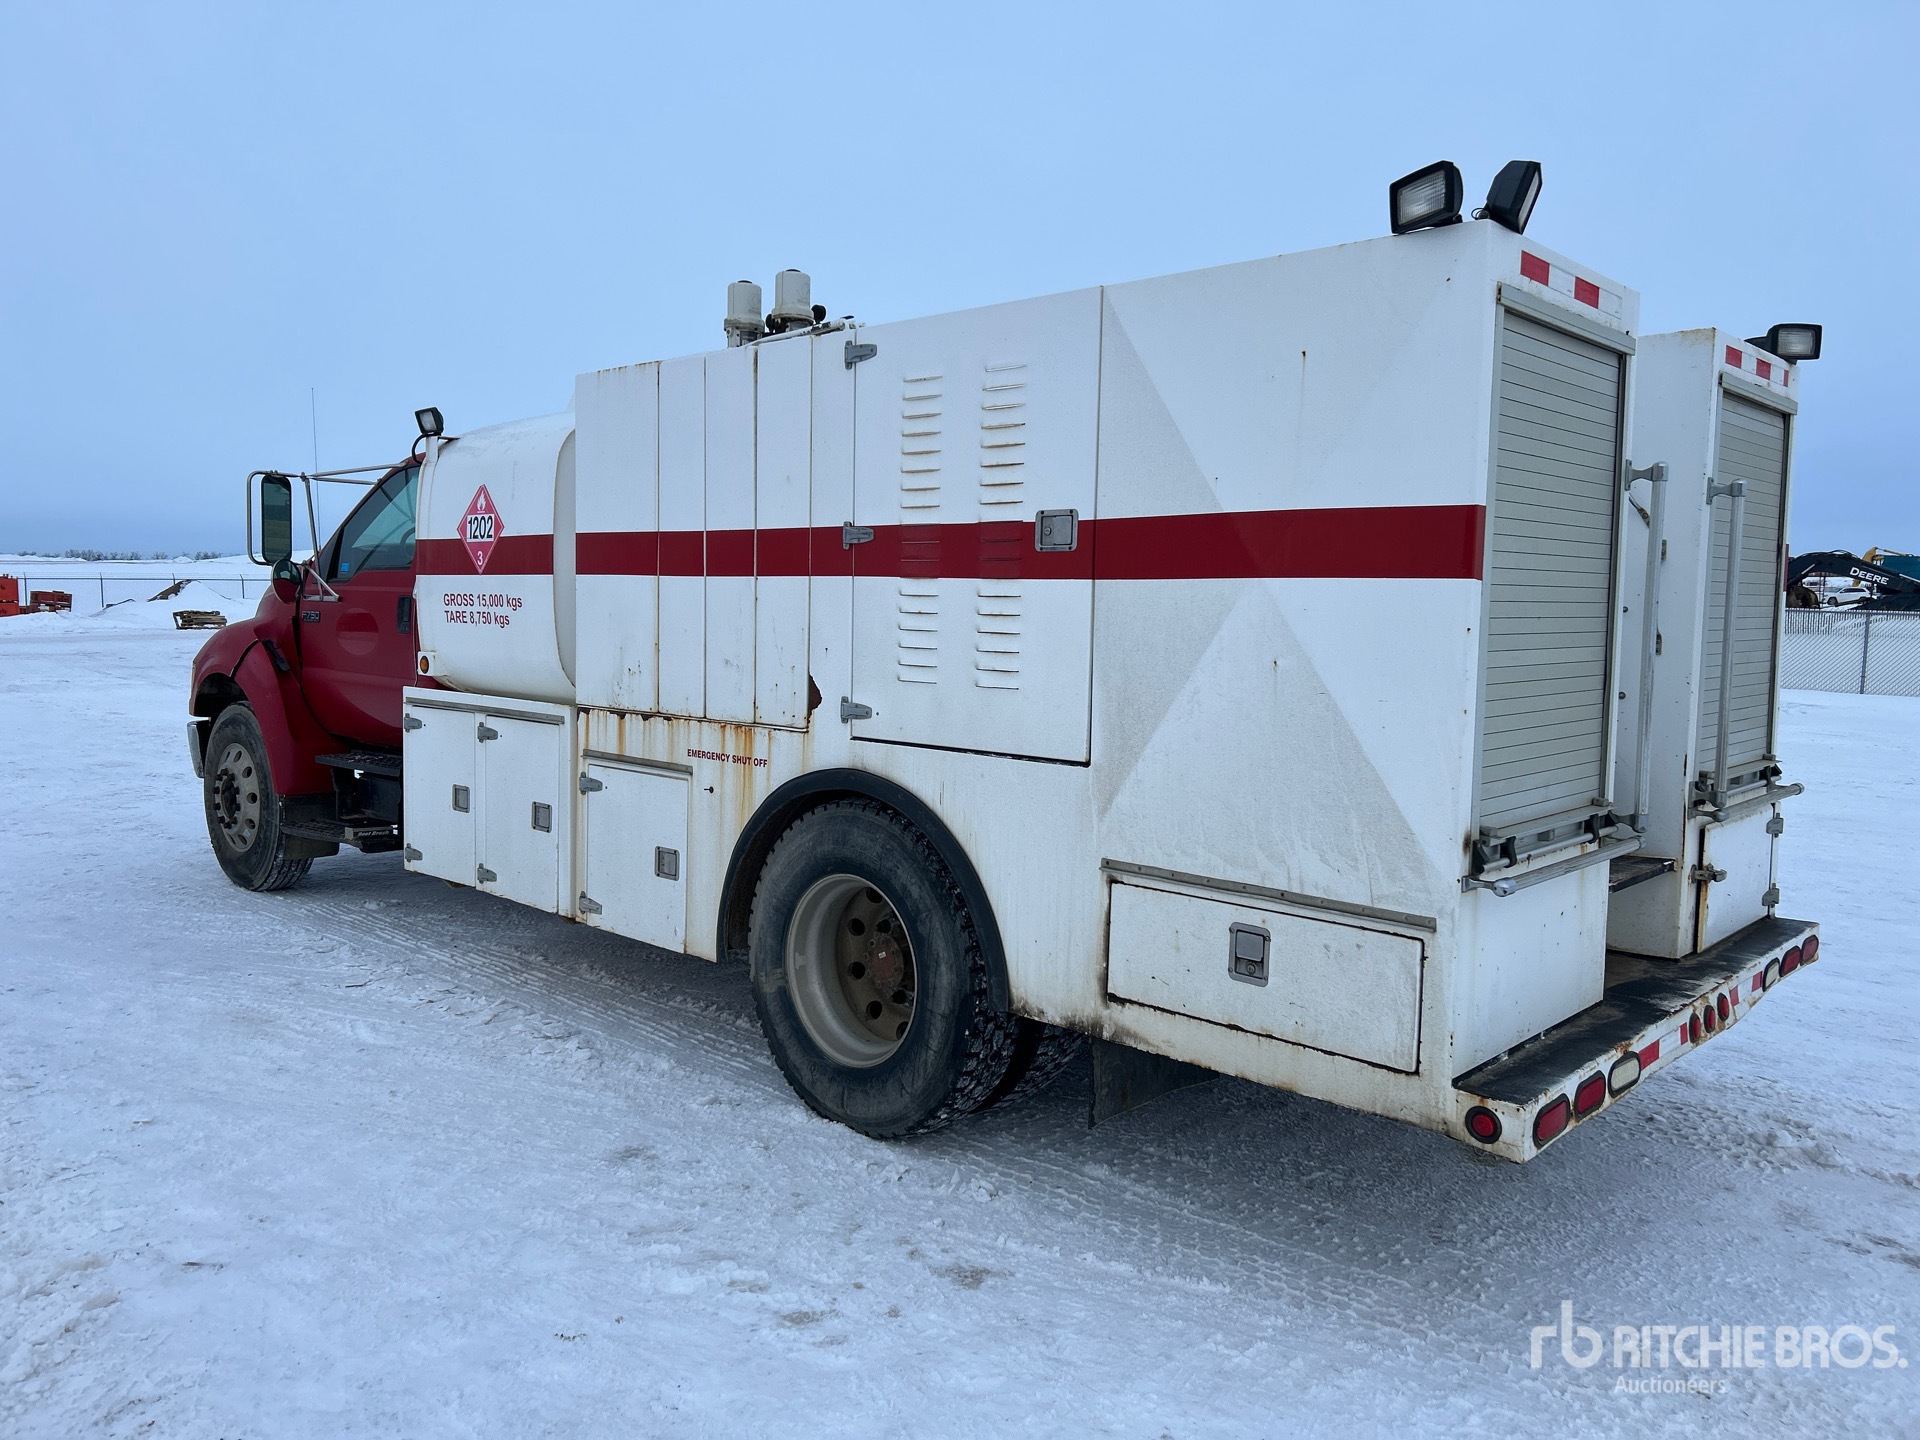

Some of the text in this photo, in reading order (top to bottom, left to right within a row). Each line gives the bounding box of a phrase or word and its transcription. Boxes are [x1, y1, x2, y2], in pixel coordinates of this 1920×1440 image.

[468, 515, 494, 540] 1202
[477, 551, 483, 566] 3
[1849, 567, 1889, 585] DEERE
[443, 593, 523, 611] GROSS 15,000 kgs
[444, 610, 510, 628] TARE 8,750 kgs
[687, 748, 768, 768] EMERGENCY SHUT OFF
